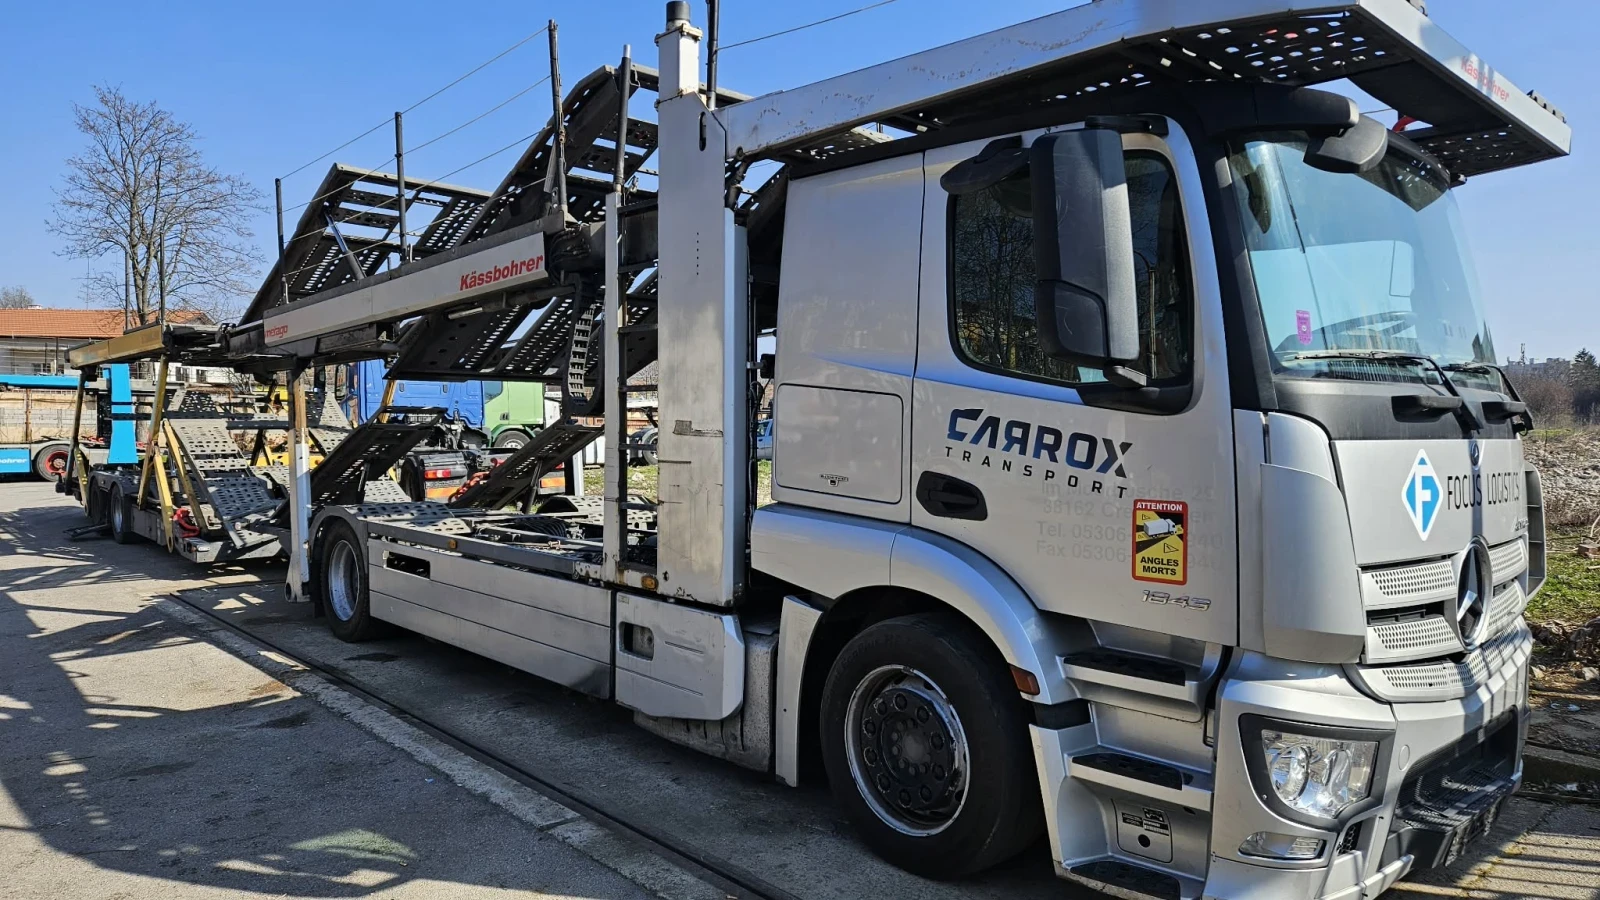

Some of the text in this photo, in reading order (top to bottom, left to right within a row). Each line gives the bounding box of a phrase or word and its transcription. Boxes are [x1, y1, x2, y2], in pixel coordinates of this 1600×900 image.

[1461, 55, 1509, 102] Kässbohrer
[459, 255, 544, 291] Kässbohrer
[947, 408, 1133, 479] CARROX
[945, 446, 1127, 499] TRANSPORT
[1136, 502, 1183, 512] ATTENTION
[1447, 472, 1519, 510] FOCUS LOGISTICS
[1036, 540, 1066, 557] Fax
[1140, 556, 1179, 567] ANGLES
[1142, 565, 1177, 576] MORTS
